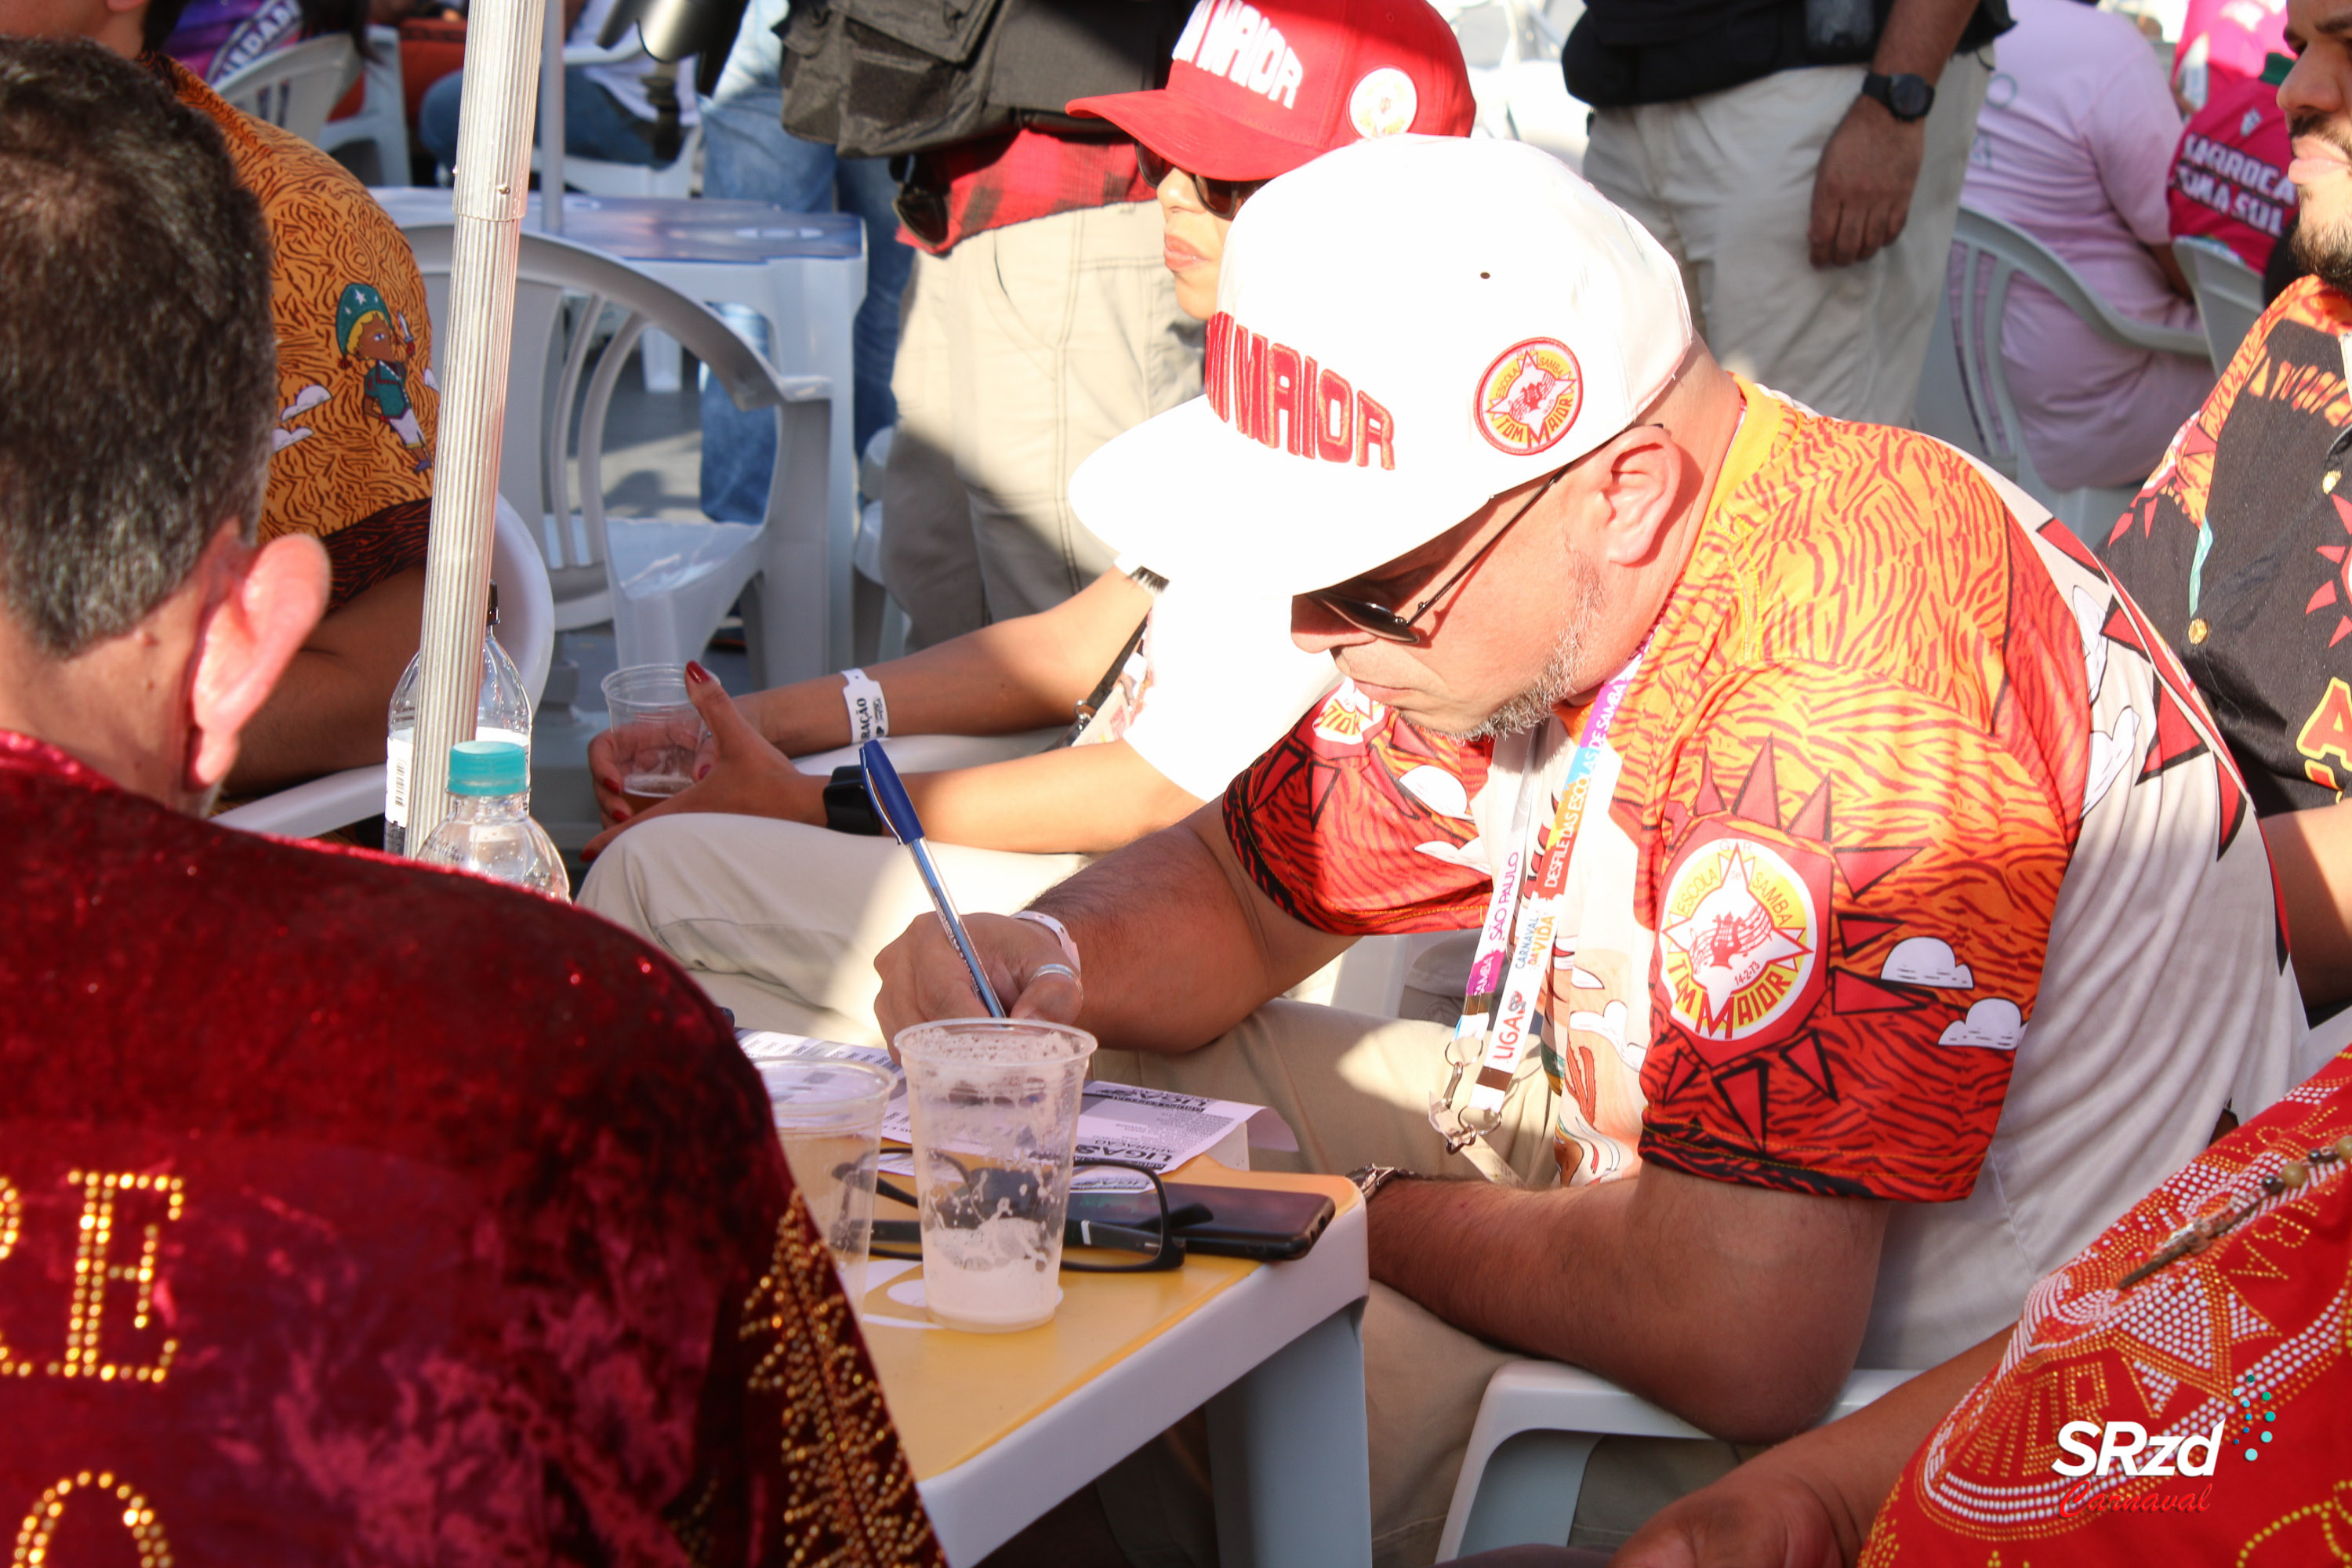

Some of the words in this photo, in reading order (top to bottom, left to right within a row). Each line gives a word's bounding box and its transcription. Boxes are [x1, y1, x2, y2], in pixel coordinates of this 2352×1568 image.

[1495, 366, 1521, 398] ESCOLA
[1538, 356, 1565, 378] SAMBA
[1496, 417, 1525, 443] TOM
[1526, 397, 1573, 450] MAIOR
[1595, 683, 1628, 731] SAMBA
[1588, 729, 1607, 750] DE
[1568, 749, 1598, 812] ESCOLAS
[1559, 811, 1580, 839] DAS
[1544, 839, 1570, 888] DESFILE
[1488, 907, 1508, 942] SÃO
[1498, 851, 1519, 906] PAULO
[1677, 866, 1722, 915] ESCOLA
[1751, 871, 1794, 927] SAMBA
[1515, 916, 1540, 971] CARNAVAL
[1533, 915, 1556, 951] VIDA
[1733, 960, 1761, 986] 14-2-73
[1695, 970, 1793, 1040] MAIOR
